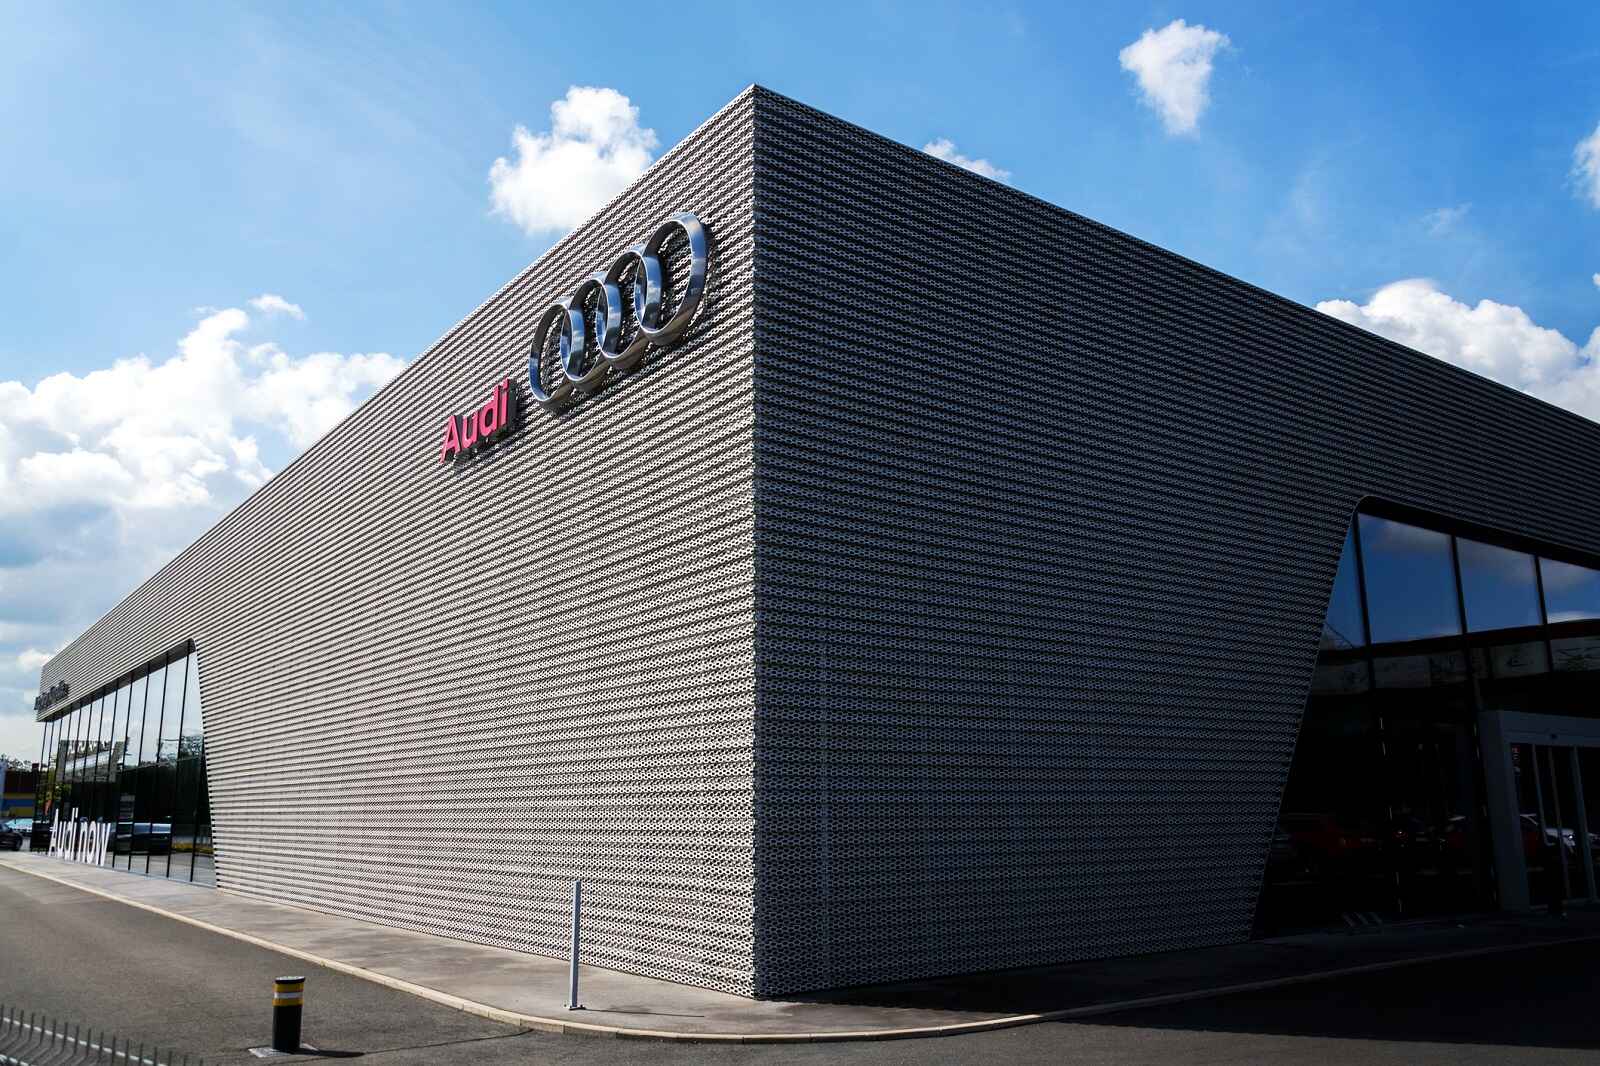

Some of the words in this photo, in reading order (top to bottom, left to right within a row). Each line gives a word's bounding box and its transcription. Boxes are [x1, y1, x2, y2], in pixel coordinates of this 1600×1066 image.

[439, 377, 510, 464] Audi
[48, 807, 79, 861] Audi
[77, 820, 111, 867] now
